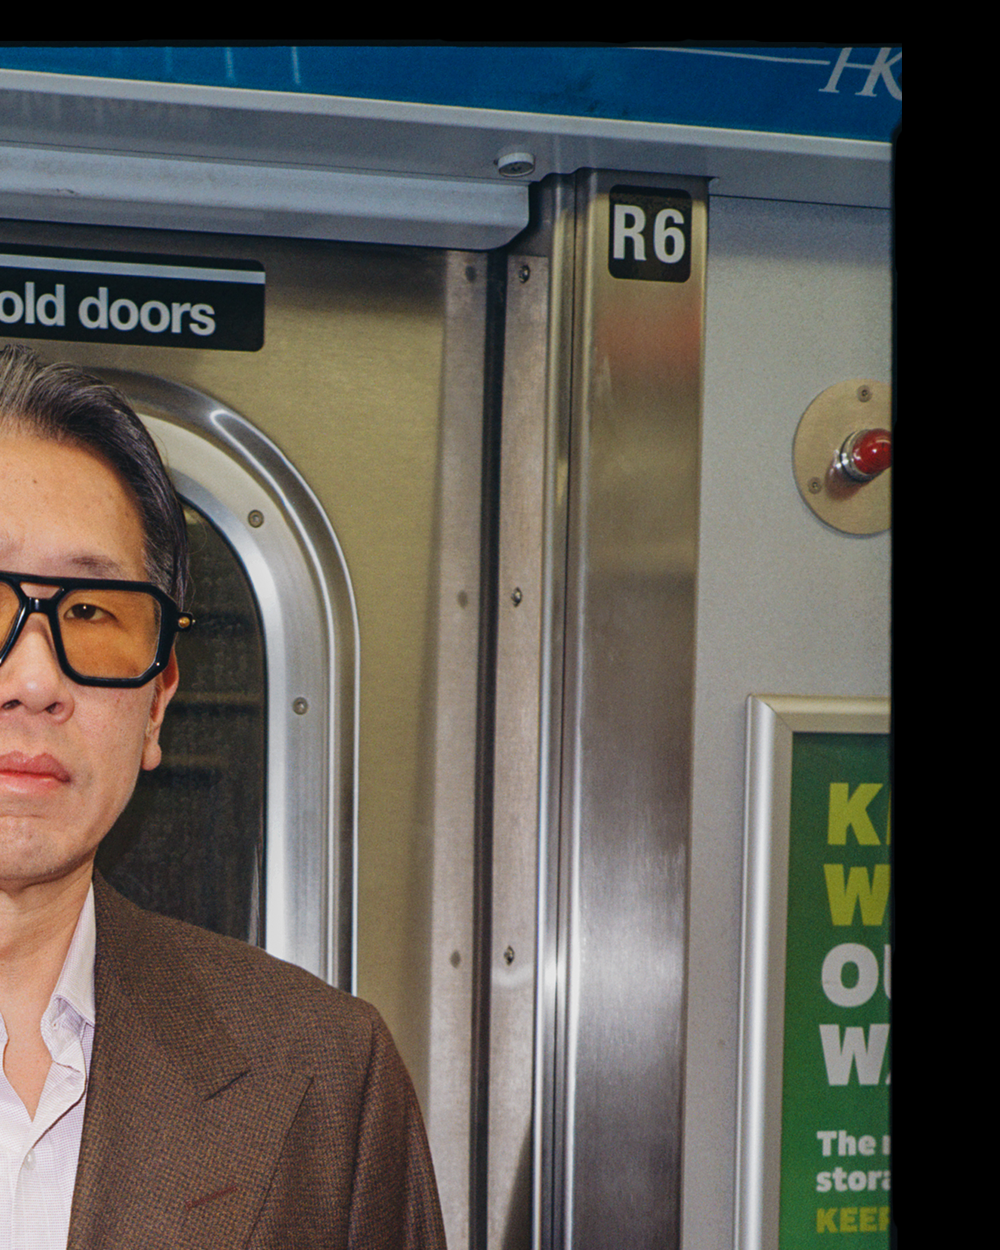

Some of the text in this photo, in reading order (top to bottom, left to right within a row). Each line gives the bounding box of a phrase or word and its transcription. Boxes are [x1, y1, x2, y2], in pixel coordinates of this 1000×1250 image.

[613, 204, 685, 264] R6
[78, 286, 217, 336] doors
[827, 782, 891, 845] K
[821, 942, 891, 1008] O
[819, 1023, 891, 1086] W
[816, 1129, 877, 1157] The
